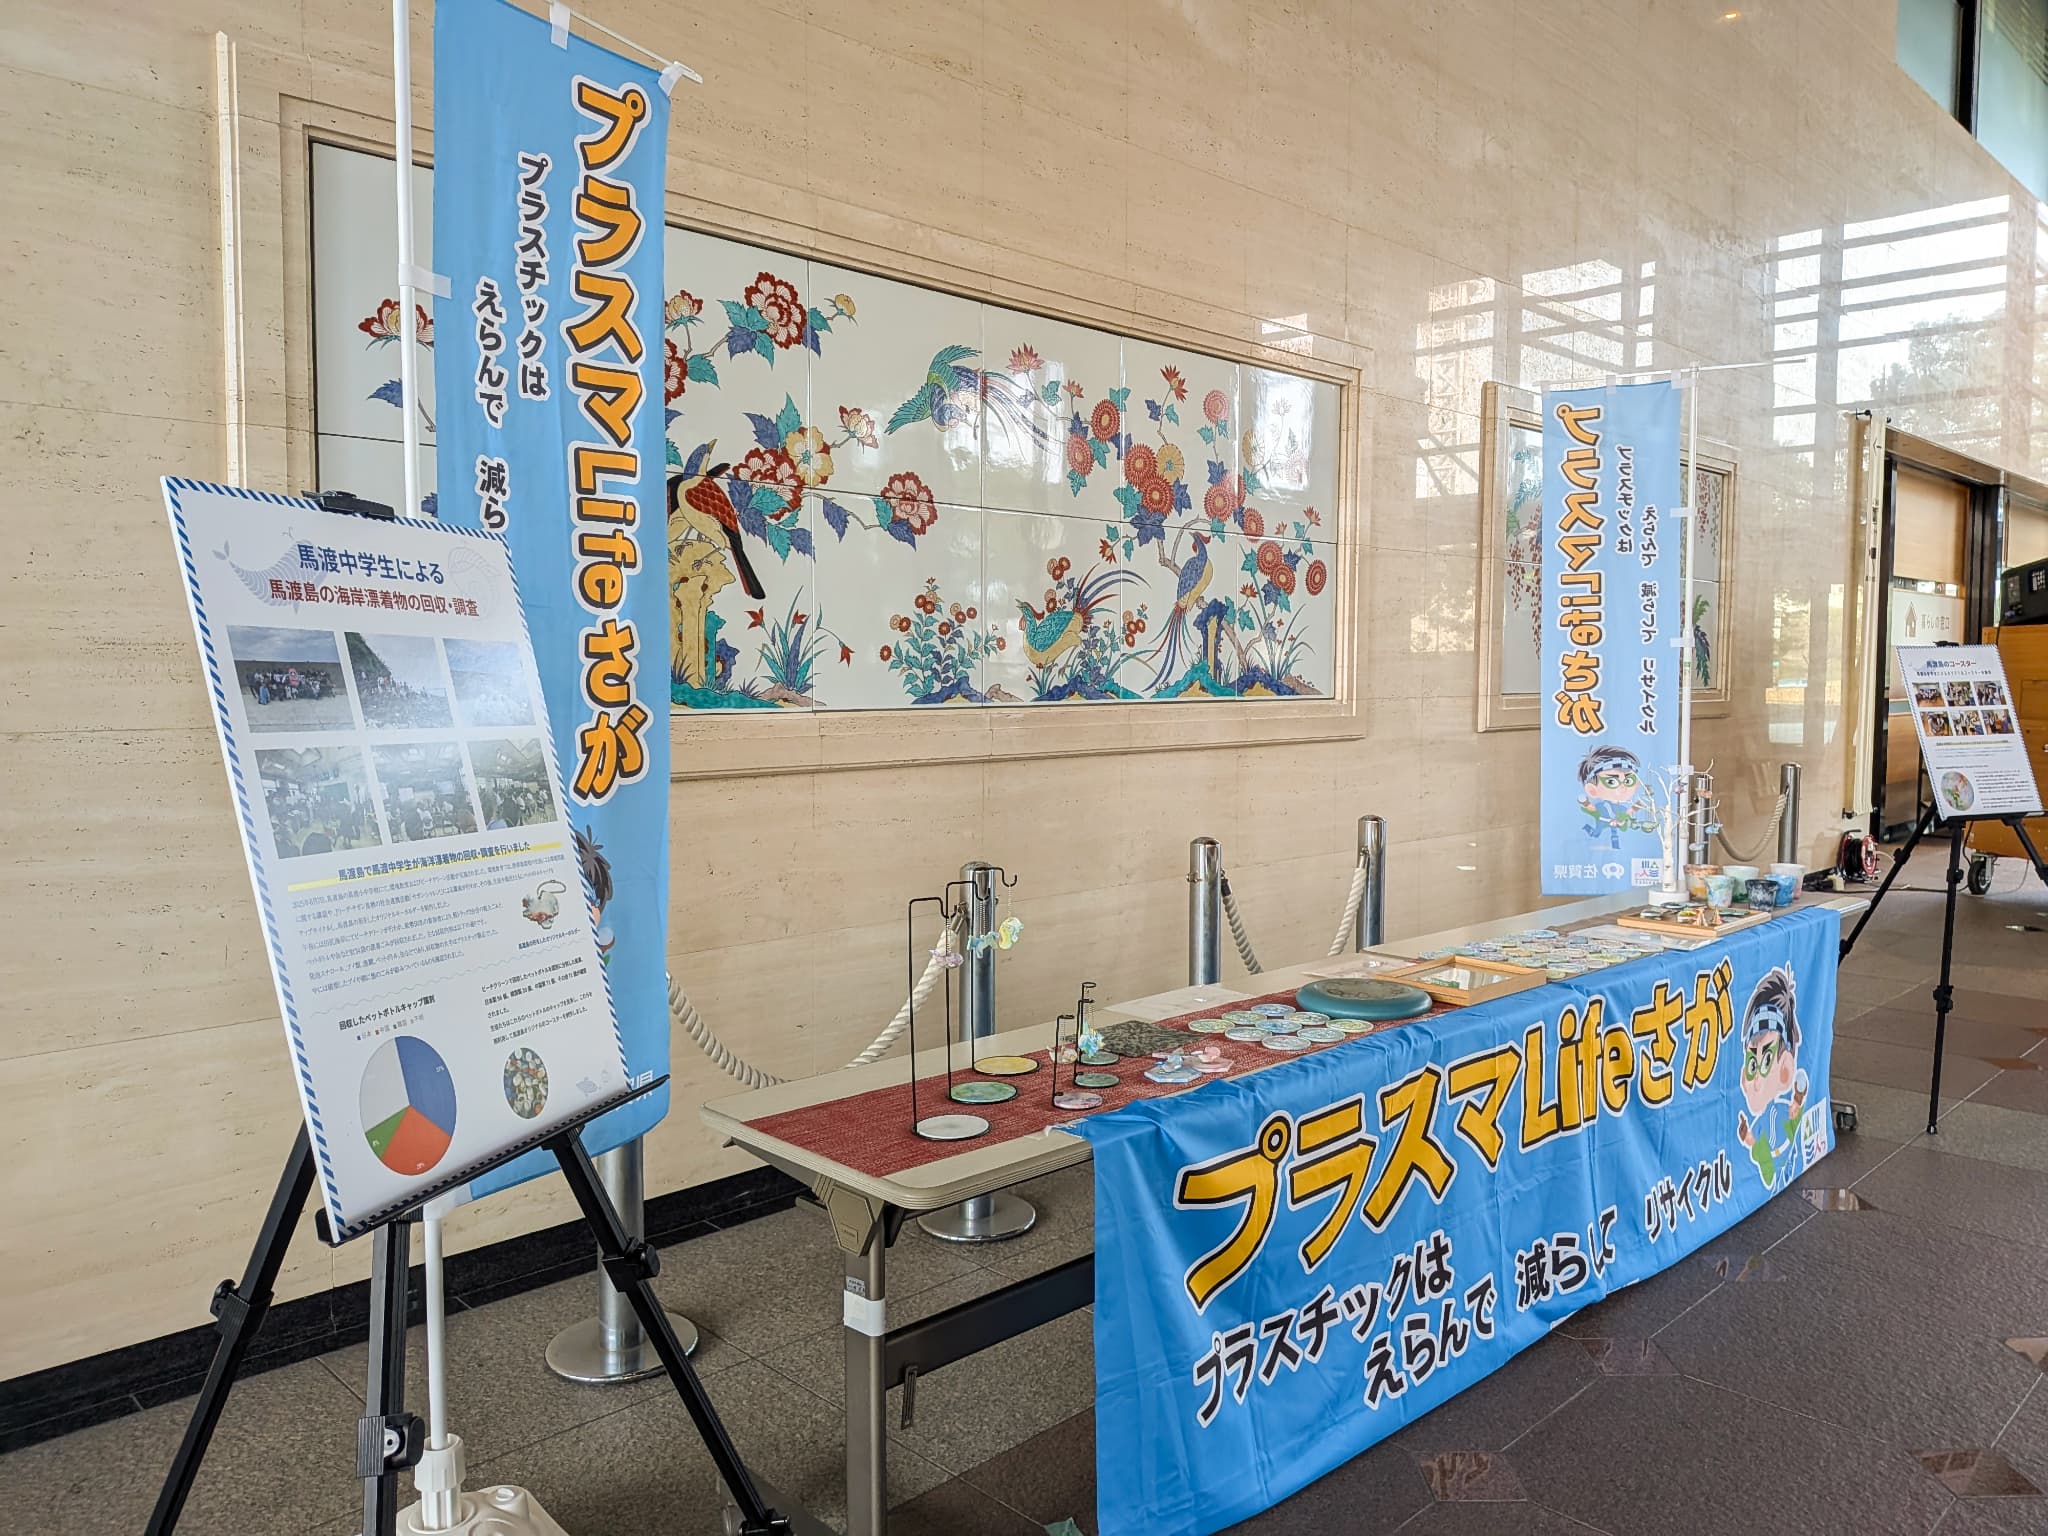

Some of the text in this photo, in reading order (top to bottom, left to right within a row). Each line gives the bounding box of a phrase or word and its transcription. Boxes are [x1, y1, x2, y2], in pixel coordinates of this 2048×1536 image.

[475, 281, 504, 424] えらんで
[518, 156, 549, 397] プラスチックは
[565, 81, 648, 800] プラスマLifeさが
[269, 579, 480, 618] 馬渡島の海岸漂着物の回収・調査
[298, 543, 445, 585] 馬渡中学生による
[1178, 959, 1732, 1310] プラスマLifeさが
[1194, 1229, 1453, 1425] プラスチックは
[1365, 1158, 1732, 1408] えらんで 減らして リサイクル
